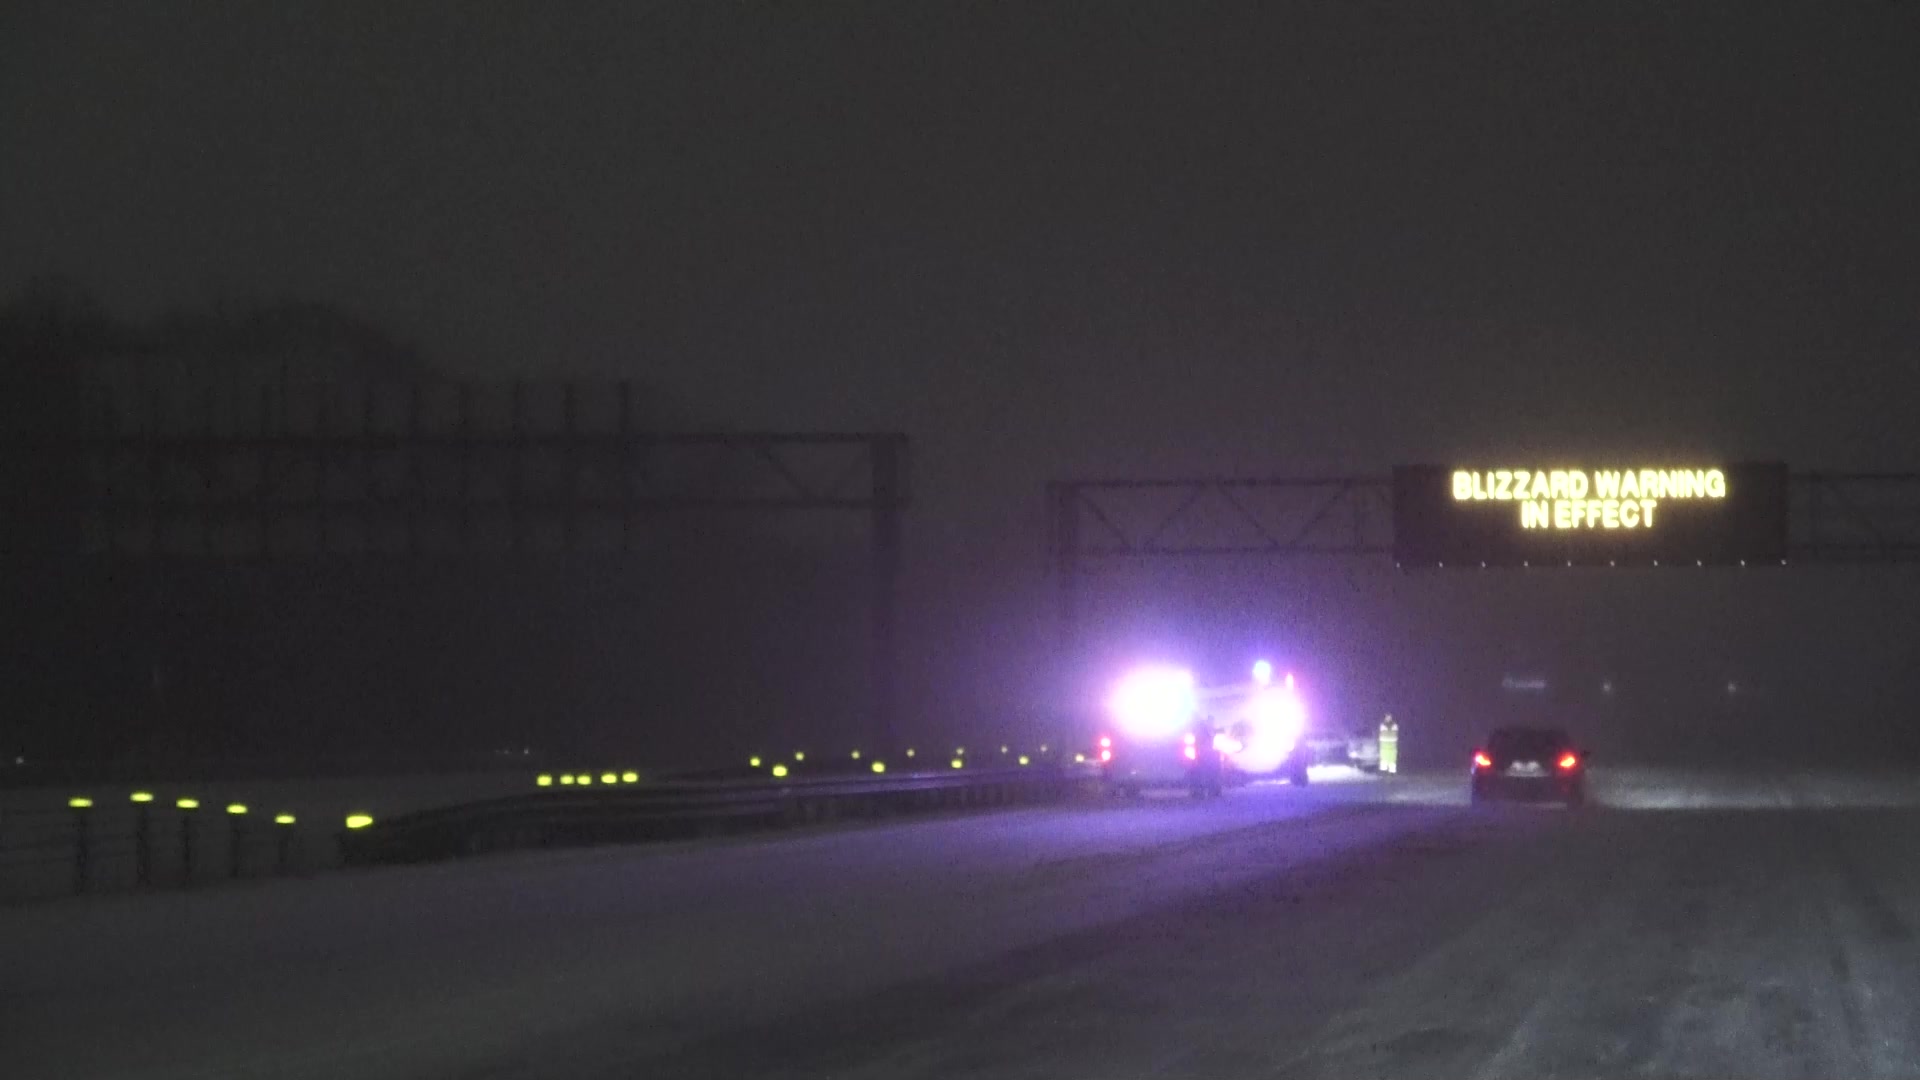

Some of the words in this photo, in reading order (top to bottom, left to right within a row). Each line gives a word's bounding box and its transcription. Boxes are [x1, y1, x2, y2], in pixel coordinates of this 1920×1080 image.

[1452, 470, 1589, 500] BLIZZARD
[1595, 469, 1726, 498] WARNING
[1521, 500, 1549, 529] IN
[1554, 500, 1657, 529] EFFECT
